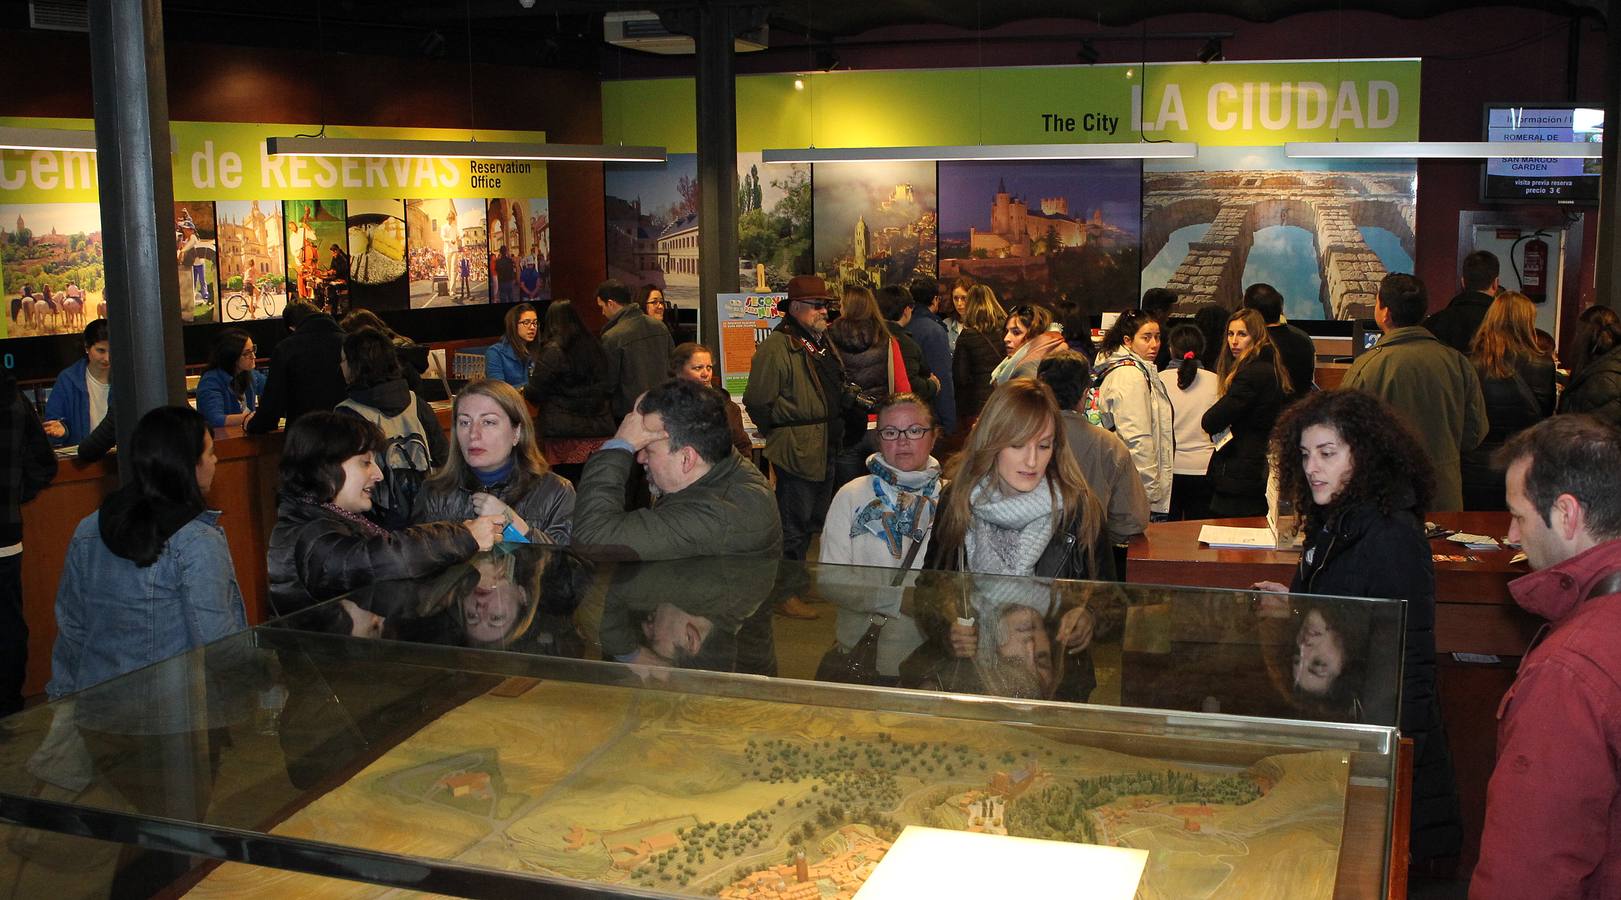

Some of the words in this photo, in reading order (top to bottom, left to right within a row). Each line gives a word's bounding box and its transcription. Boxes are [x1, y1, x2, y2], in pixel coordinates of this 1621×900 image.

[1131, 84, 1189, 131] LA
[1207, 80, 1399, 130] CIUDAD
[1042, 113, 1075, 132] The
[1083, 112, 1119, 135] City
[191, 141, 242, 188] de
[260, 142, 460, 188] RESERVAS
[470, 161, 531, 174] Reservation
[471, 175, 501, 188] Office
[1515, 178, 1531, 186] visita
[1532, 179, 1550, 187] previa
[1525, 187, 1546, 195] precio
